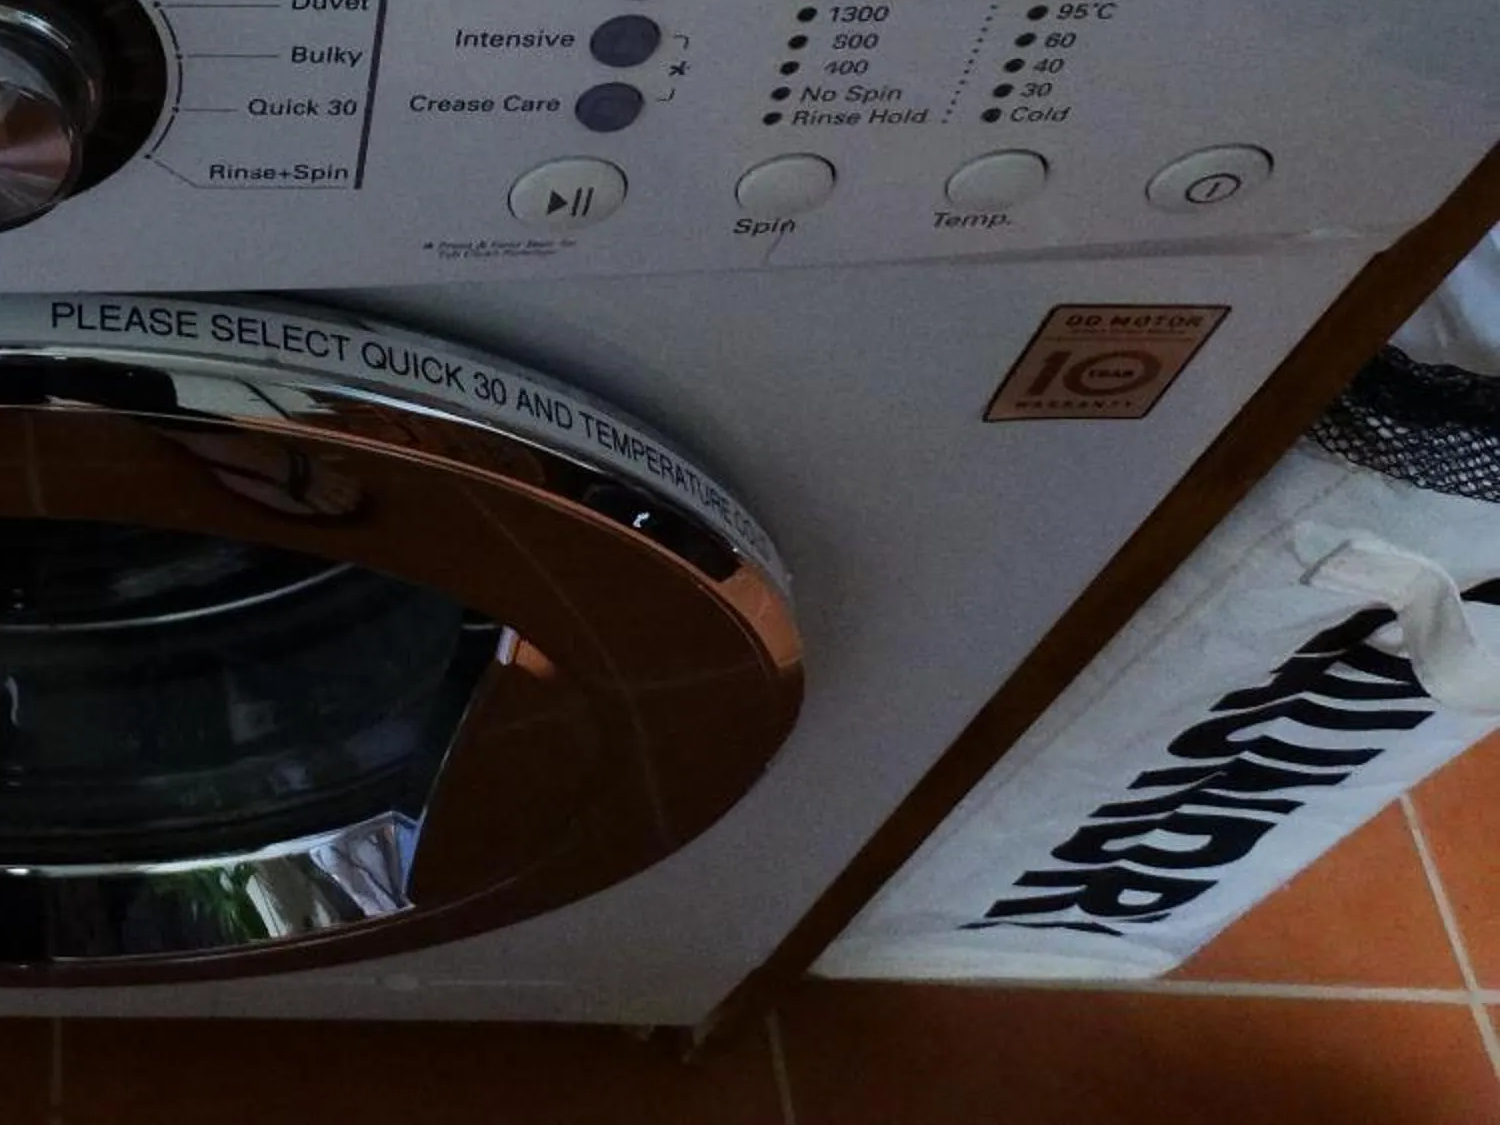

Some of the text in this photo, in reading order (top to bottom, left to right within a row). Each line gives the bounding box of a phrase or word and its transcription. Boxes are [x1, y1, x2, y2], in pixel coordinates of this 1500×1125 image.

[831, 5, 890, 23] 1300
[455, 29, 576, 48] Intensive
[1044, 32, 1077, 49] 60
[291, 45, 363, 66] Bulky
[1033, 58, 1065, 74] 40
[800, 84, 902, 105] No Spin
[1020, 82, 1053, 98] 30
[247, 98, 357, 116] Quick 30
[409, 94, 561, 112] Crease Care
[792, 108, 929, 126] Rinse Hold
[1010, 106, 1071, 123] Cold
[209, 164, 349, 184] Rinse+Spin
[733, 218, 796, 237] Spin
[934, 212, 1011, 229] Temp.
[1110, 315, 1204, 328] MOTOR
[51, 302, 198, 338] PLEASE
[210, 314, 351, 361] SELECT
[361, 341, 467, 393] QUICK
[473, 372, 507, 406] 30
[516, 387, 574, 429] AND
[578, 411, 733, 526] TEMPERATURE
